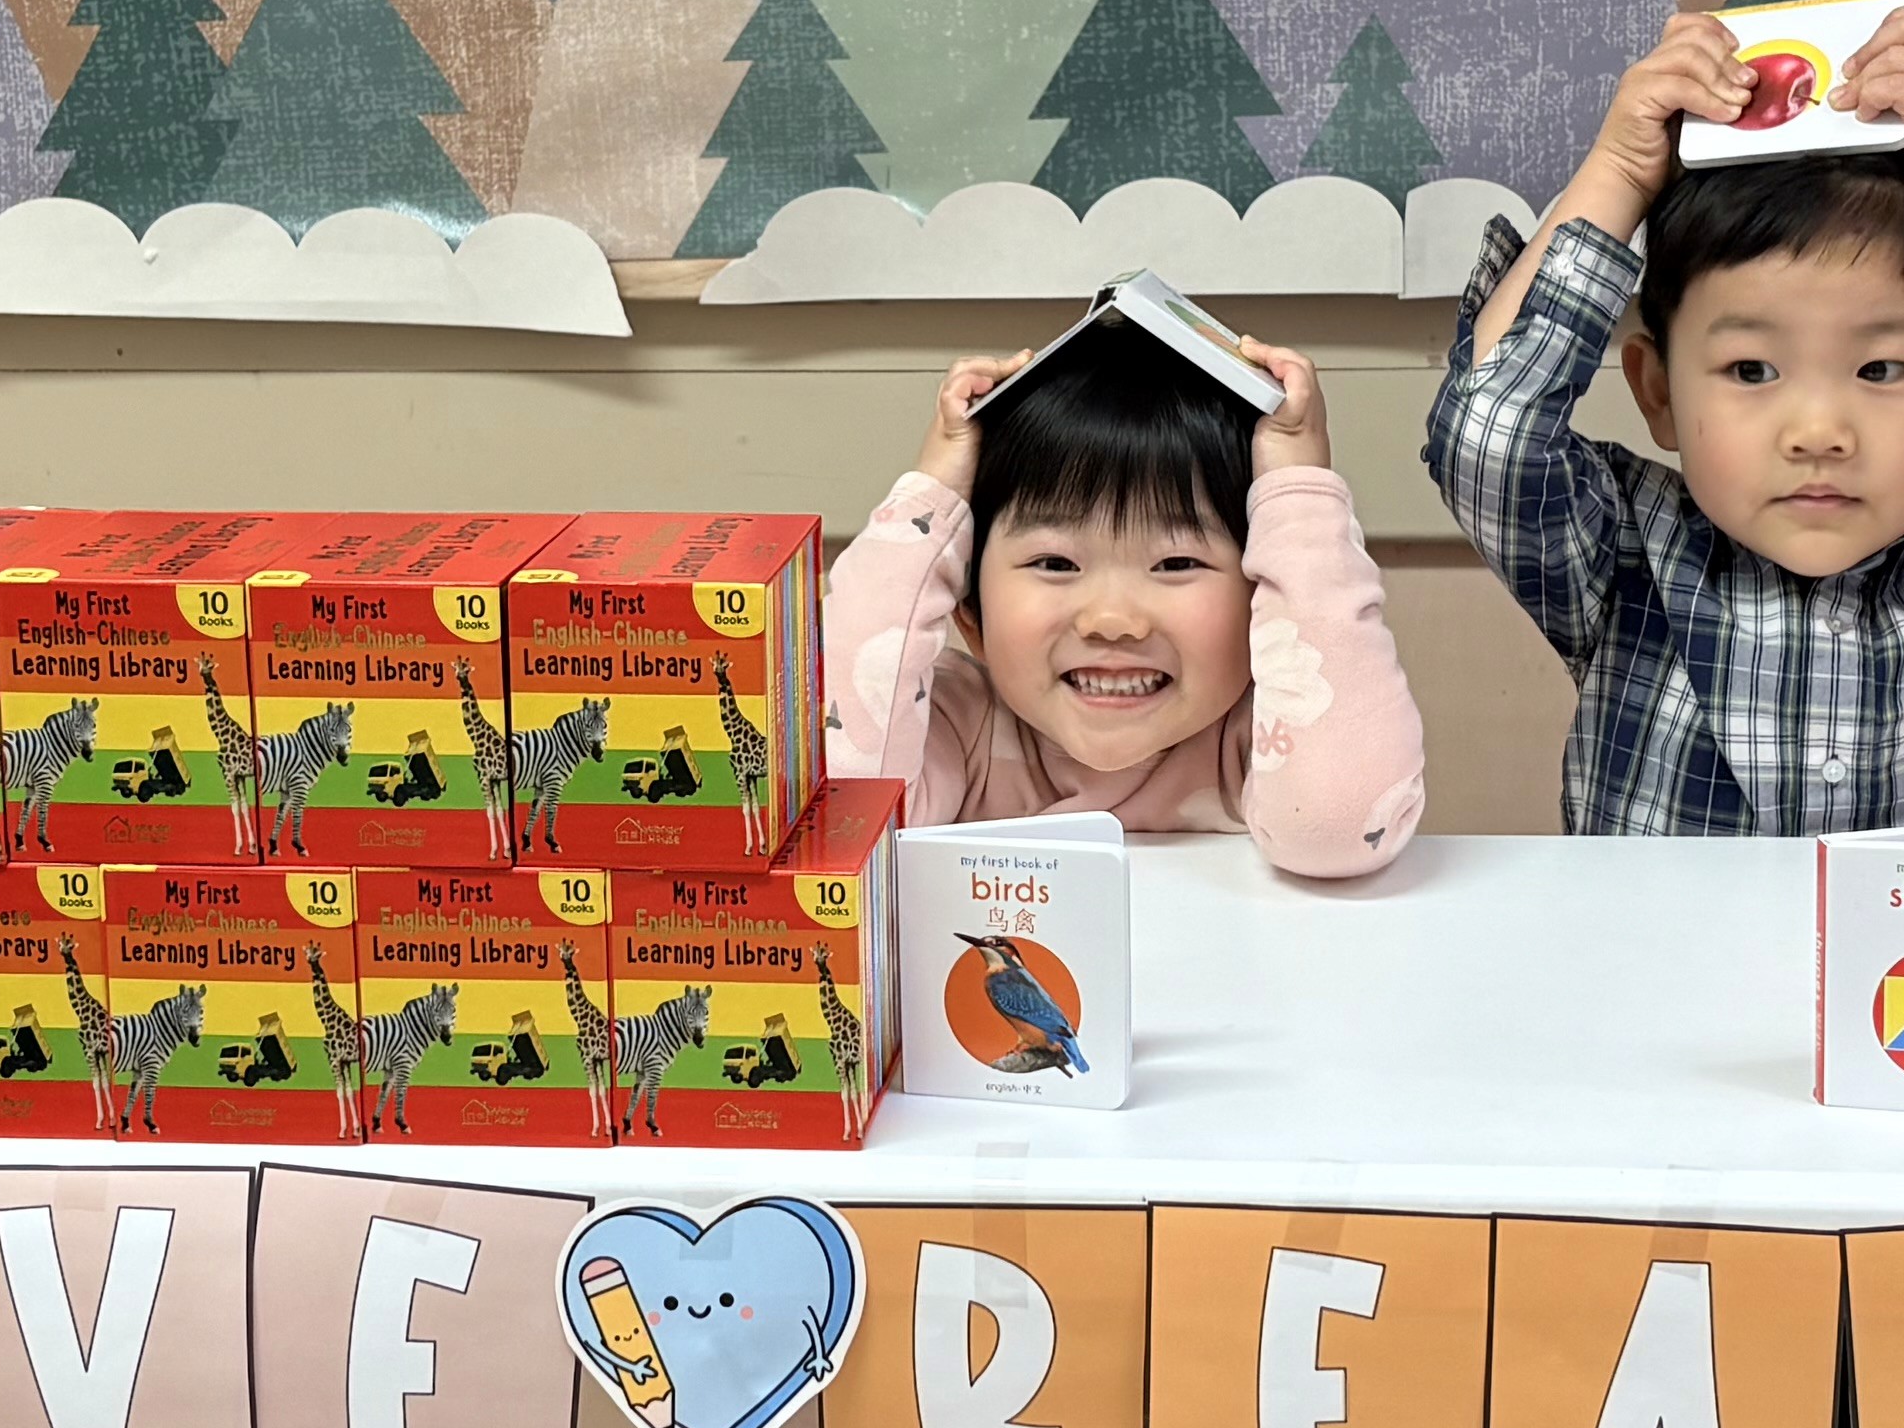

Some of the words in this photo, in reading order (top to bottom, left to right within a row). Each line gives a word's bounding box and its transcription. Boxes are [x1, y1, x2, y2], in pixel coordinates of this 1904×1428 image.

[55, 591, 80, 619] My
[87, 591, 131, 616] First
[198, 591, 229, 614] 10
[569, 589, 595, 616] My
[600, 591, 645, 614] First
[715, 590, 746, 614] 10
[199, 616, 234, 627] Books
[714, 614, 750, 626] Books
[11, 649, 100, 681] Learning
[109, 651, 188, 683] Library
[523, 649, 613, 680] Learning
[622, 650, 702, 683] Library
[960, 855, 977, 868] my
[981, 855, 1010, 868] first
[1014, 857, 1041, 869] book
[1046, 858, 1059, 871] of
[59, 874, 89, 897] 10
[672, 881, 697, 909] My
[703, 881, 749, 906] First
[816, 881, 846, 905] 10
[971, 872, 1050, 903] birds
[59, 897, 94, 909] Books
[815, 905, 850, 917] Books
[986, 907, 1036, 934] 鸟禽
[626, 937, 715, 969] Learning
[724, 940, 803, 972] Library
